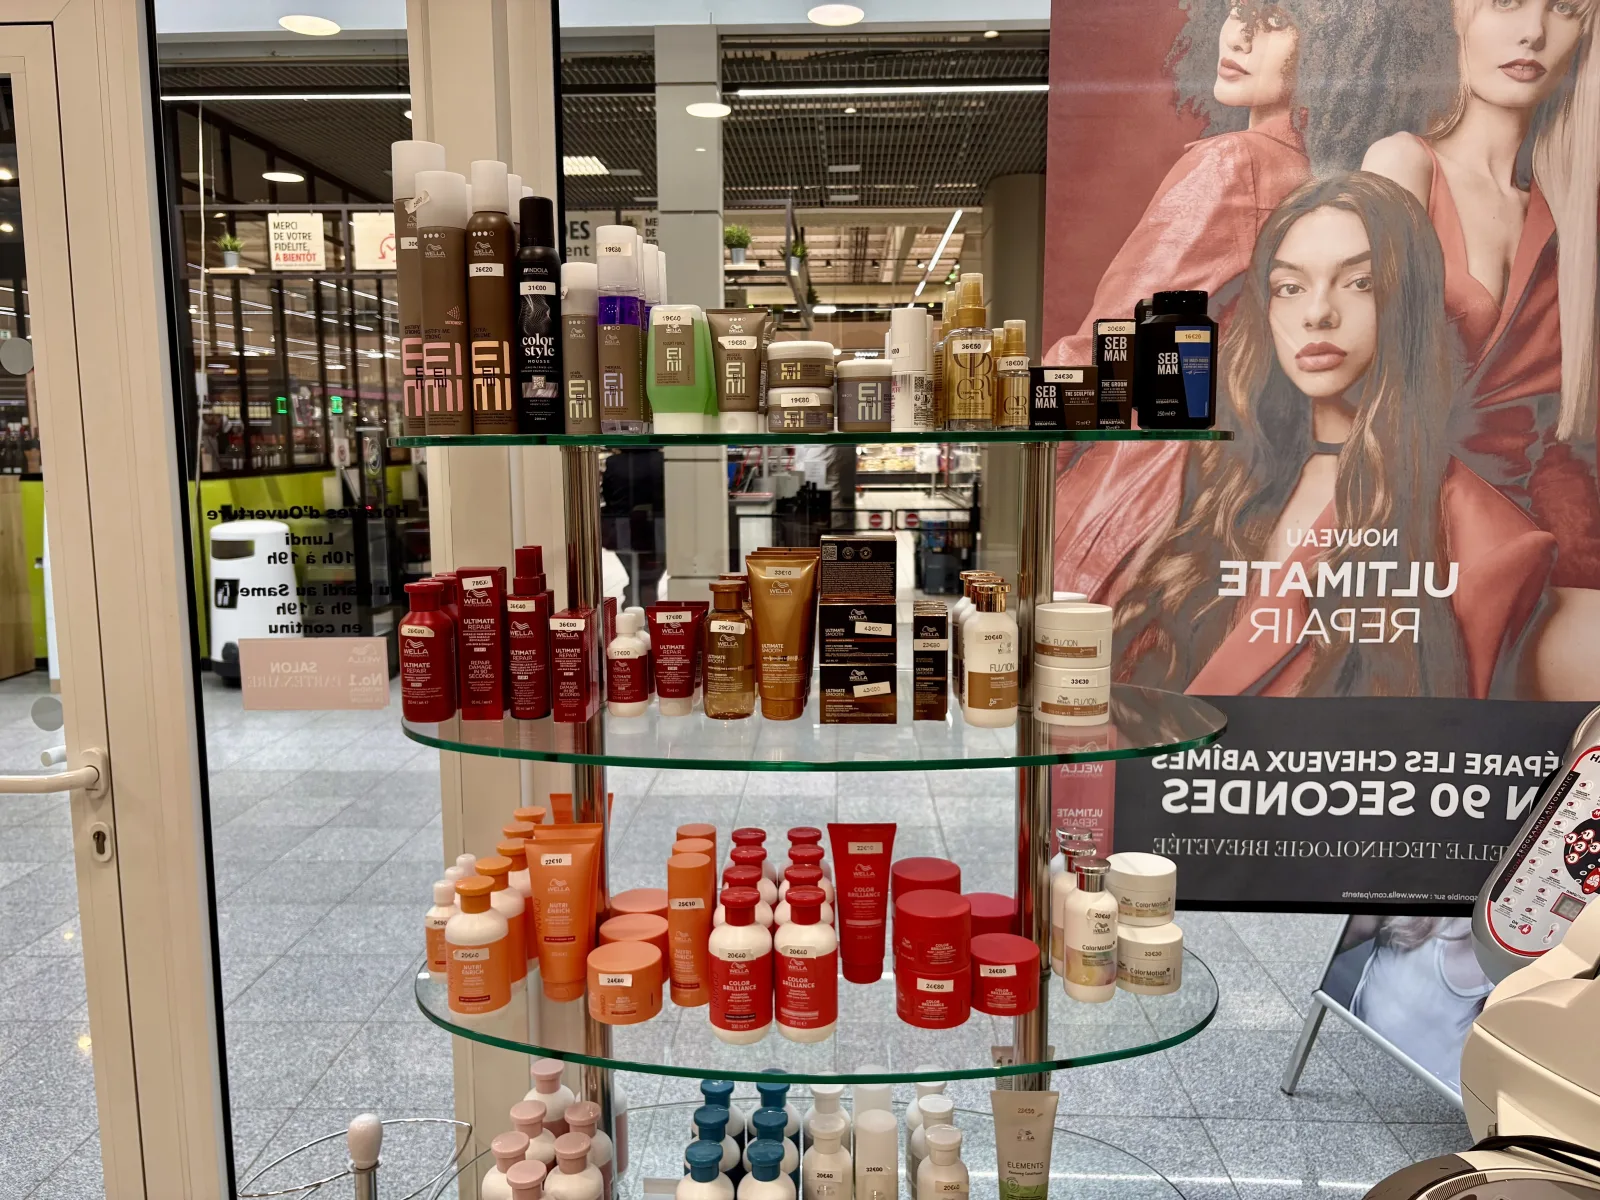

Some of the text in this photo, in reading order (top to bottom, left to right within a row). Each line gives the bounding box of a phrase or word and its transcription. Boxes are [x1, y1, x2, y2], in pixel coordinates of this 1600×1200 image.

[273, 221, 298, 230] MERCI
[565, 220, 590, 240] ES
[273, 232, 313, 241] DE VOTRE
[565, 244, 590, 257] ent
[522, 333, 555, 346] color
[1104, 336, 1128, 350] SEB
[524, 345, 555, 359] style
[1104, 349, 1128, 361] MAN
[1157, 352, 1179, 364] SEB
[1157, 363, 1179, 375] MAN
[1035, 385, 1057, 398] SEB
[1035, 397, 1057, 409] MAN
[1053, 638, 1079, 647] FUSION
[989, 662, 1015, 672] FUSION
[1073, 697, 1097, 705] FUSION
[544, 857, 562, 865] 22€10
[1135, 900, 1169, 909] ColorMotion
[1081, 943, 1113, 952] ColorMotion
[727, 951, 746, 960] 20€40
[1129, 967, 1167, 976] ColorMotion
[782, 979, 816, 989] BRILLIANCE
[1006, 1161, 1044, 1170] ELEMENTS
